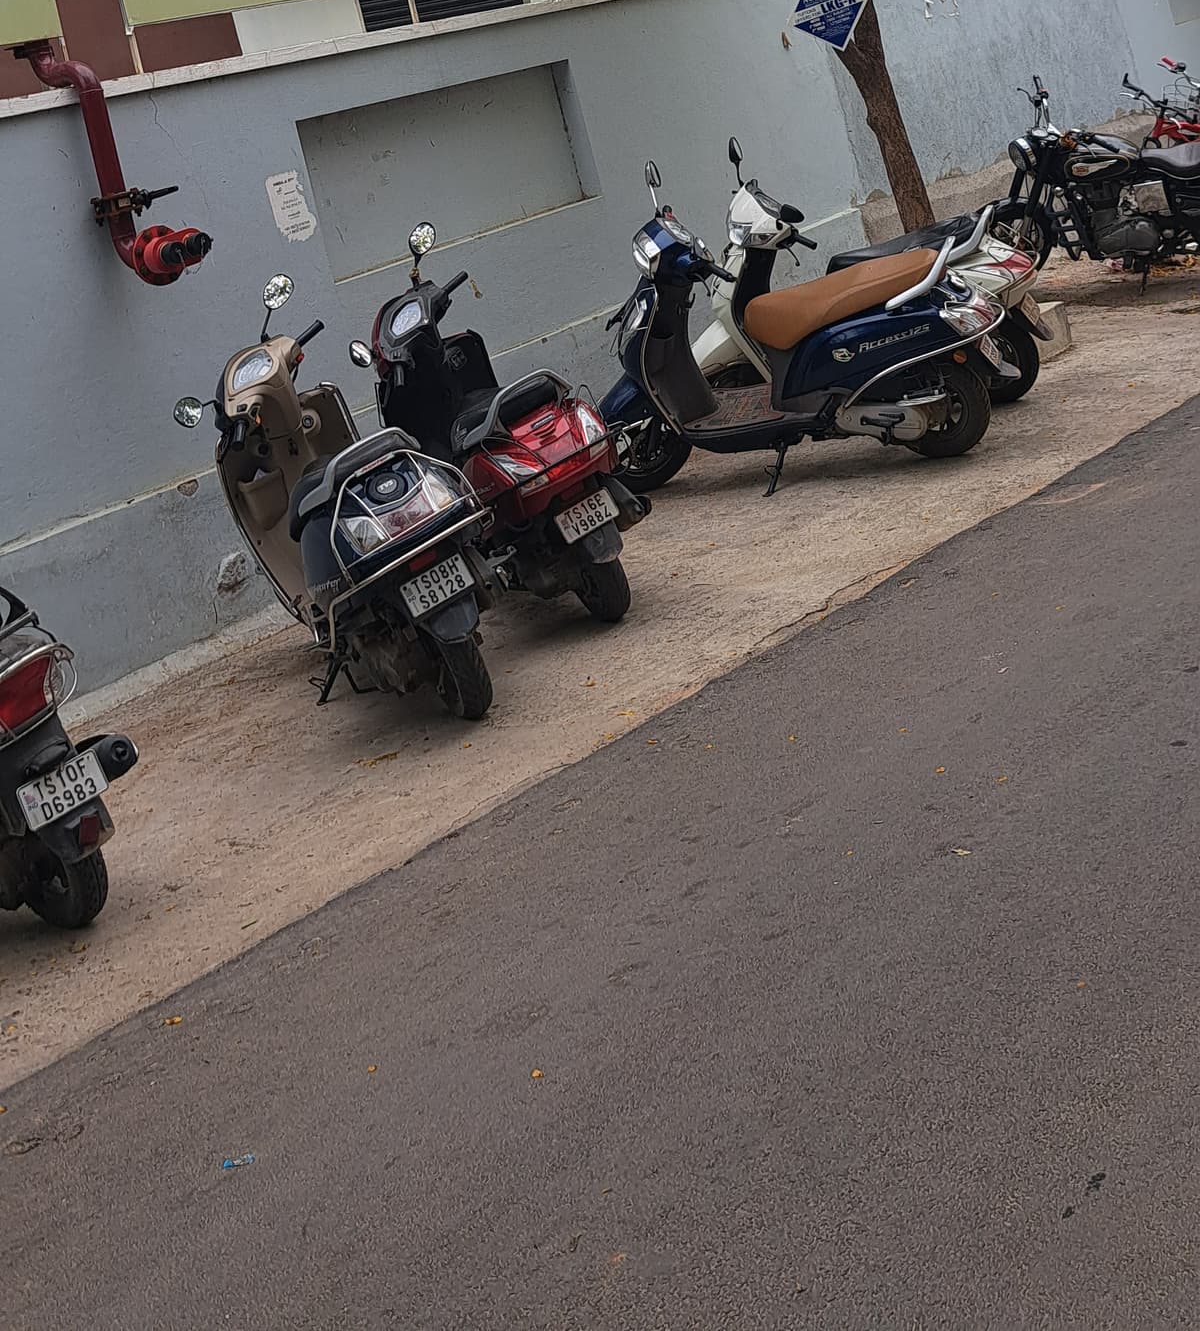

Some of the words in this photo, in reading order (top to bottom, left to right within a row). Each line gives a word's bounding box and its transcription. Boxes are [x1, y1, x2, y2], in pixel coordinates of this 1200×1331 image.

[378, 479, 394, 490] TVS
[564, 494, 606, 524] TS16E
[411, 558, 460, 594] TS08H
[419, 574, 466, 608] S8128
[33, 757, 86, 801] TS10F
[41, 777, 97, 821] D6983
